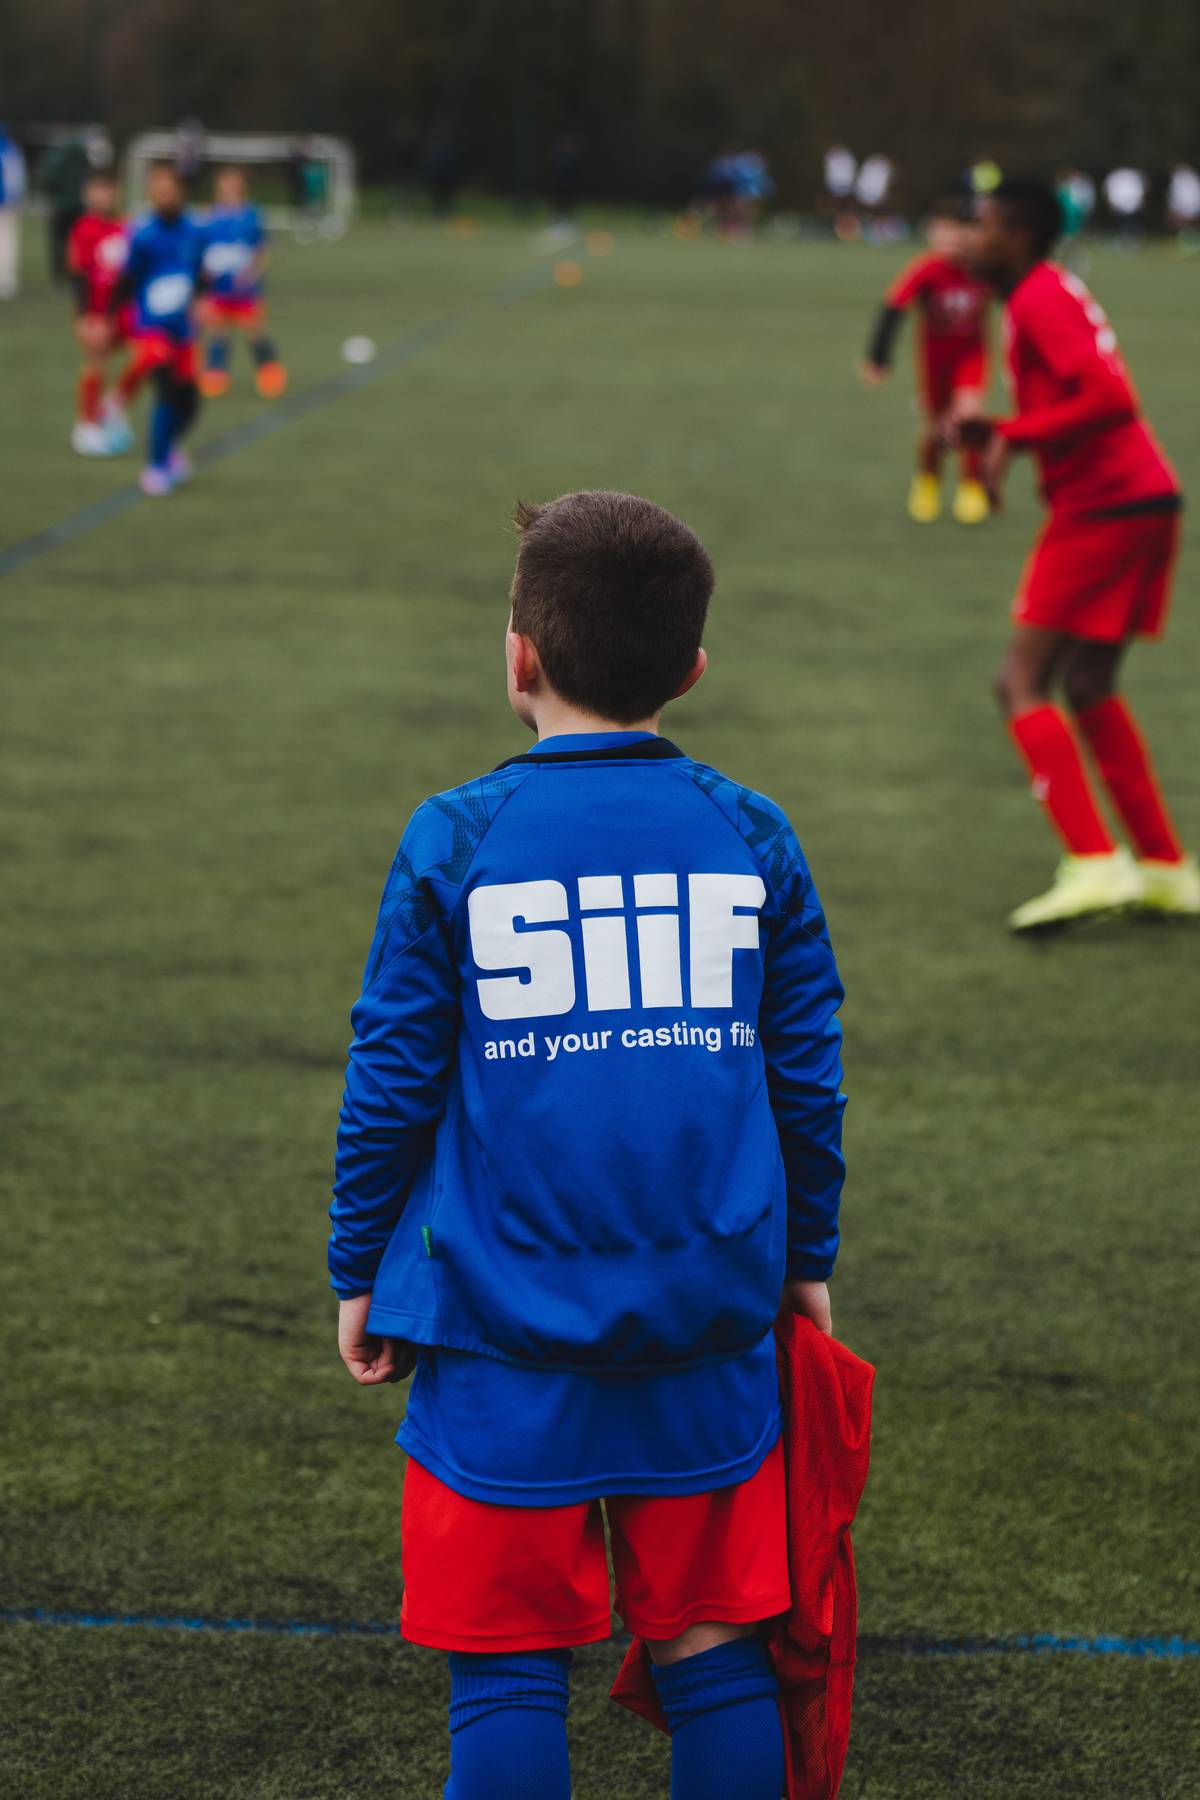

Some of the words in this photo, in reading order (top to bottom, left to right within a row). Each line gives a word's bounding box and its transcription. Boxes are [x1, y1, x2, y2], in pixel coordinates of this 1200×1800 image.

[468, 874, 767, 1020] SiiF
[484, 1031, 536, 1060] and
[544, 1030, 613, 1061] your
[621, 1021, 722, 1053] casting
[729, 1021, 755, 1047] fits
